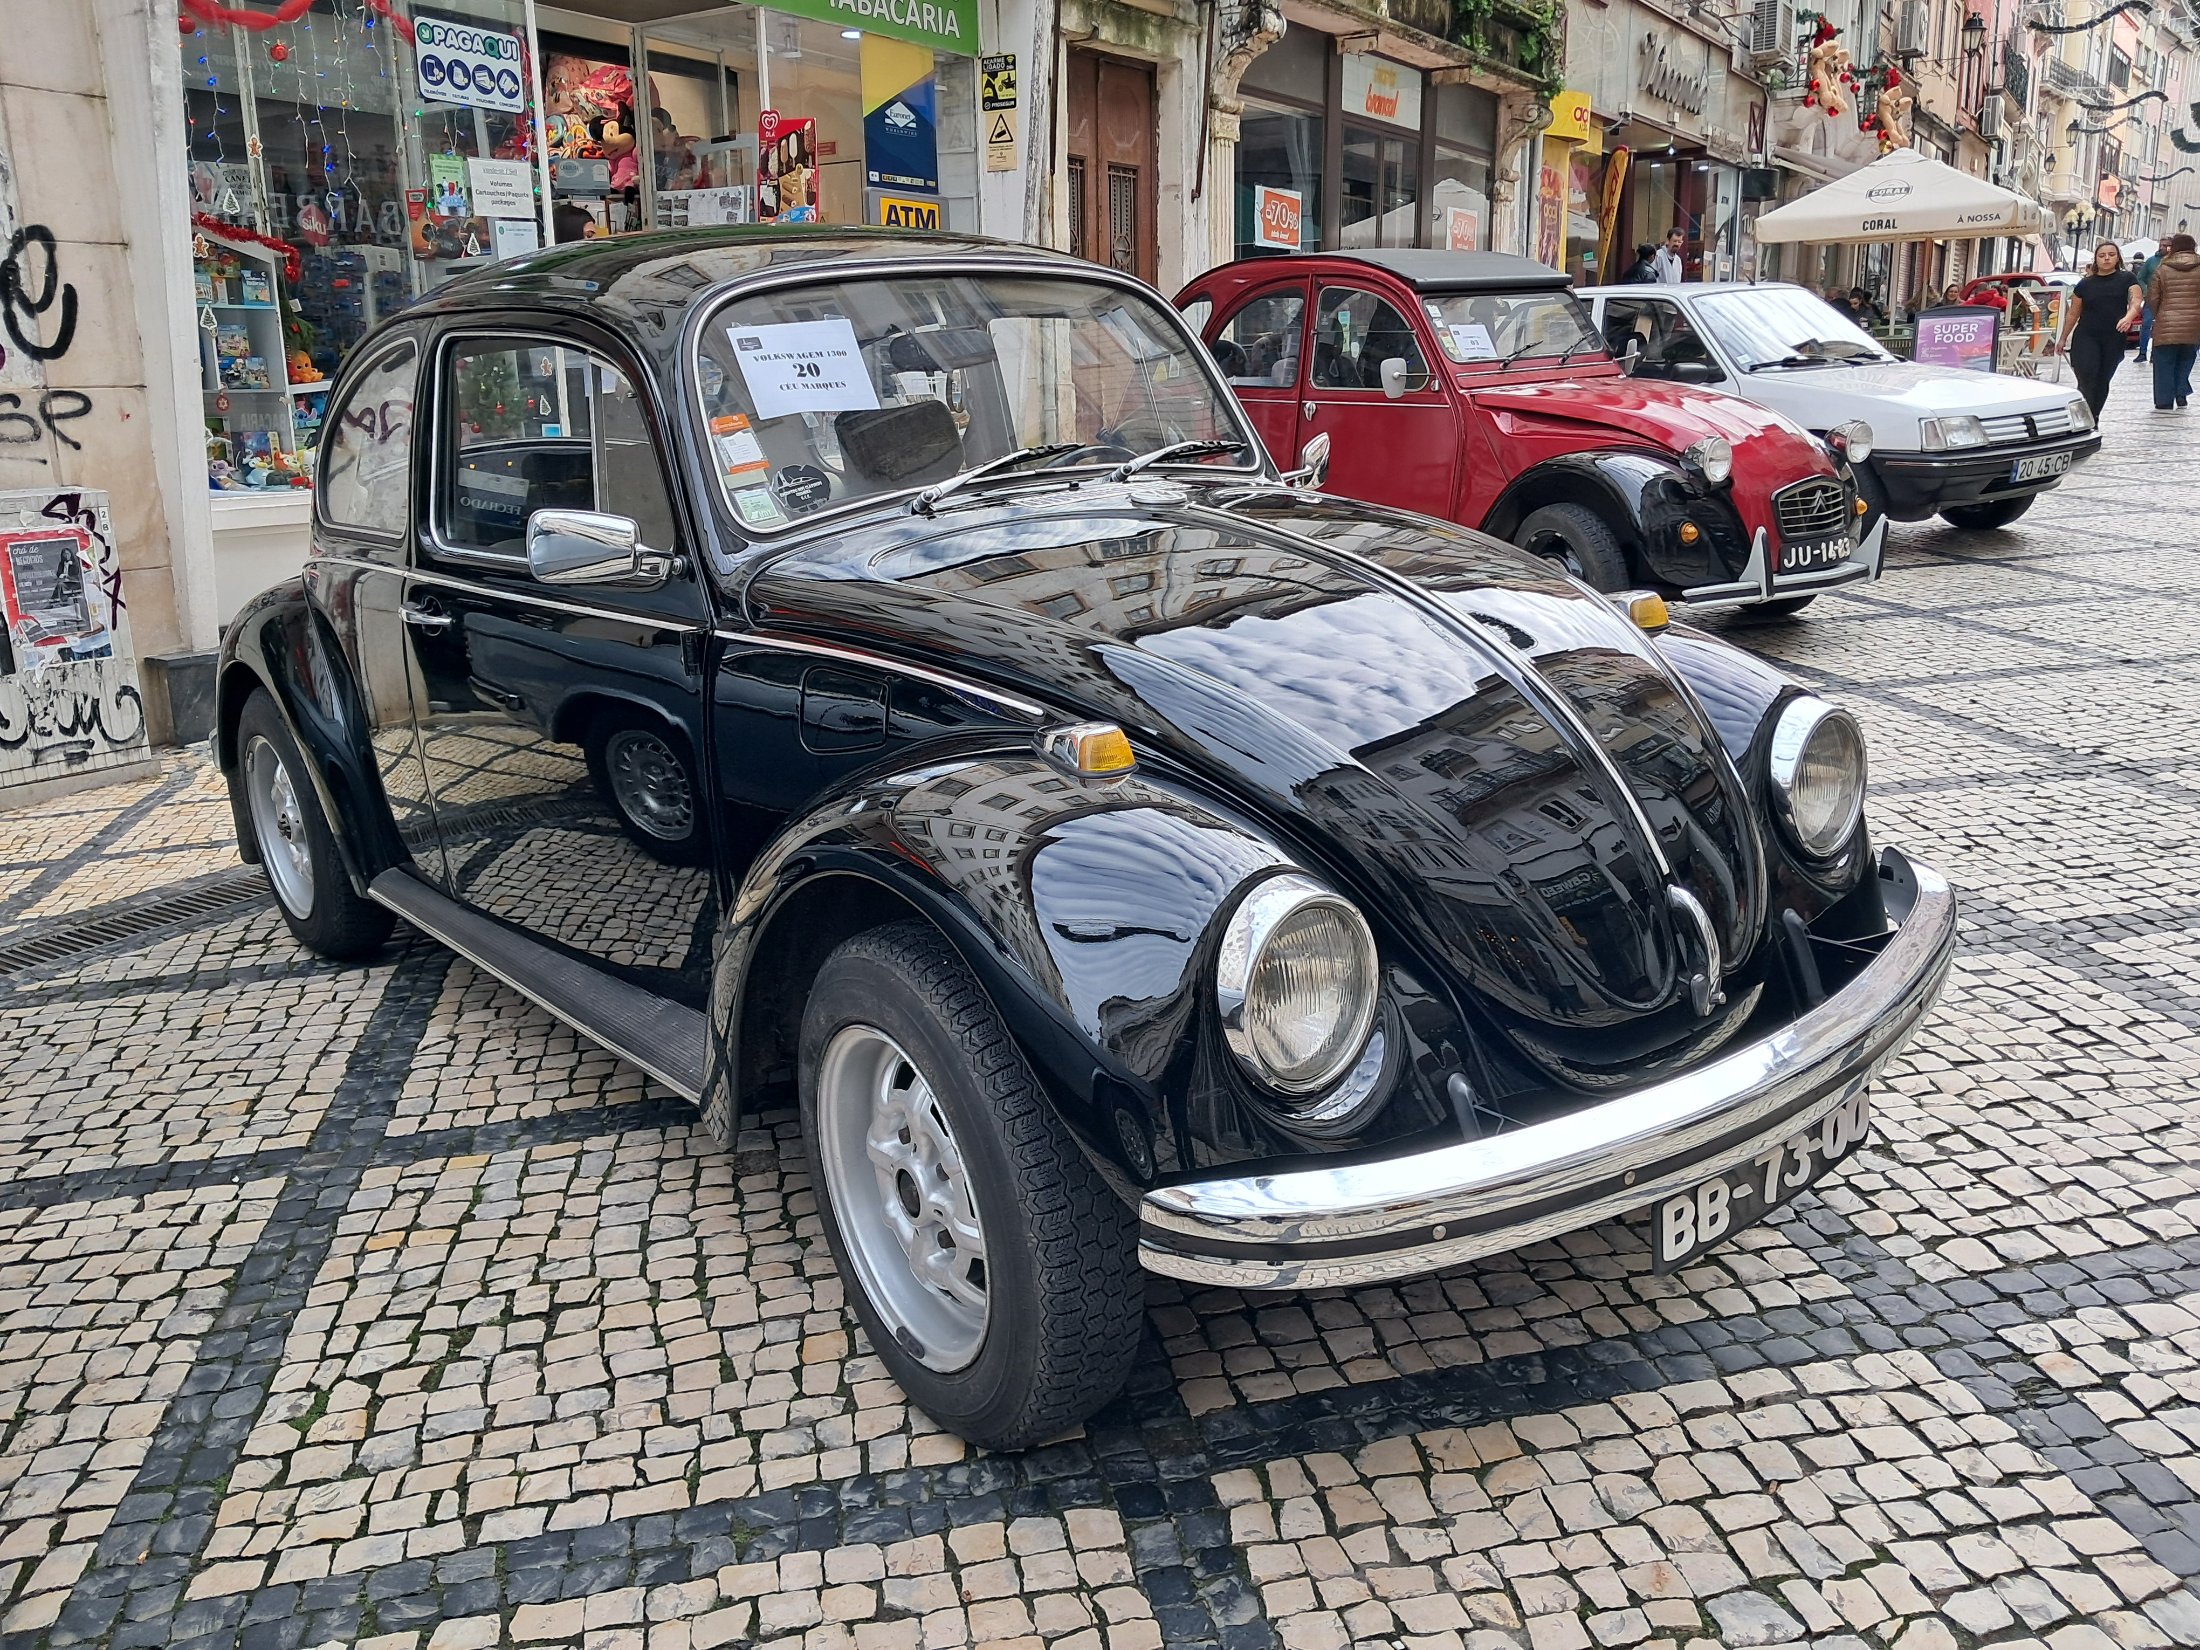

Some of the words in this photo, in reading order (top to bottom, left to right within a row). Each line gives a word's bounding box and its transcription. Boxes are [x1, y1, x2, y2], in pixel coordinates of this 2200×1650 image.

[829, 0, 961, 38] BACARIA
[1871, 186, 1909, 198] CORAL
[885, 204, 936, 231] ATM
[1957, 214, 1964, 224] À
[1967, 213, 2001, 223] NOSSA
[301, 216, 327, 236] siku
[1862, 218, 1898, 231] CORAL
[1933, 323, 1979, 334] SUPER
[1934, 333, 1975, 344] FOOD
[826, 350, 848, 358] 1300
[792, 361, 821, 378] 20
[801, 380, 847, 391] MARQUES
[1662, 1091, 1869, 1263] BB-73-00
